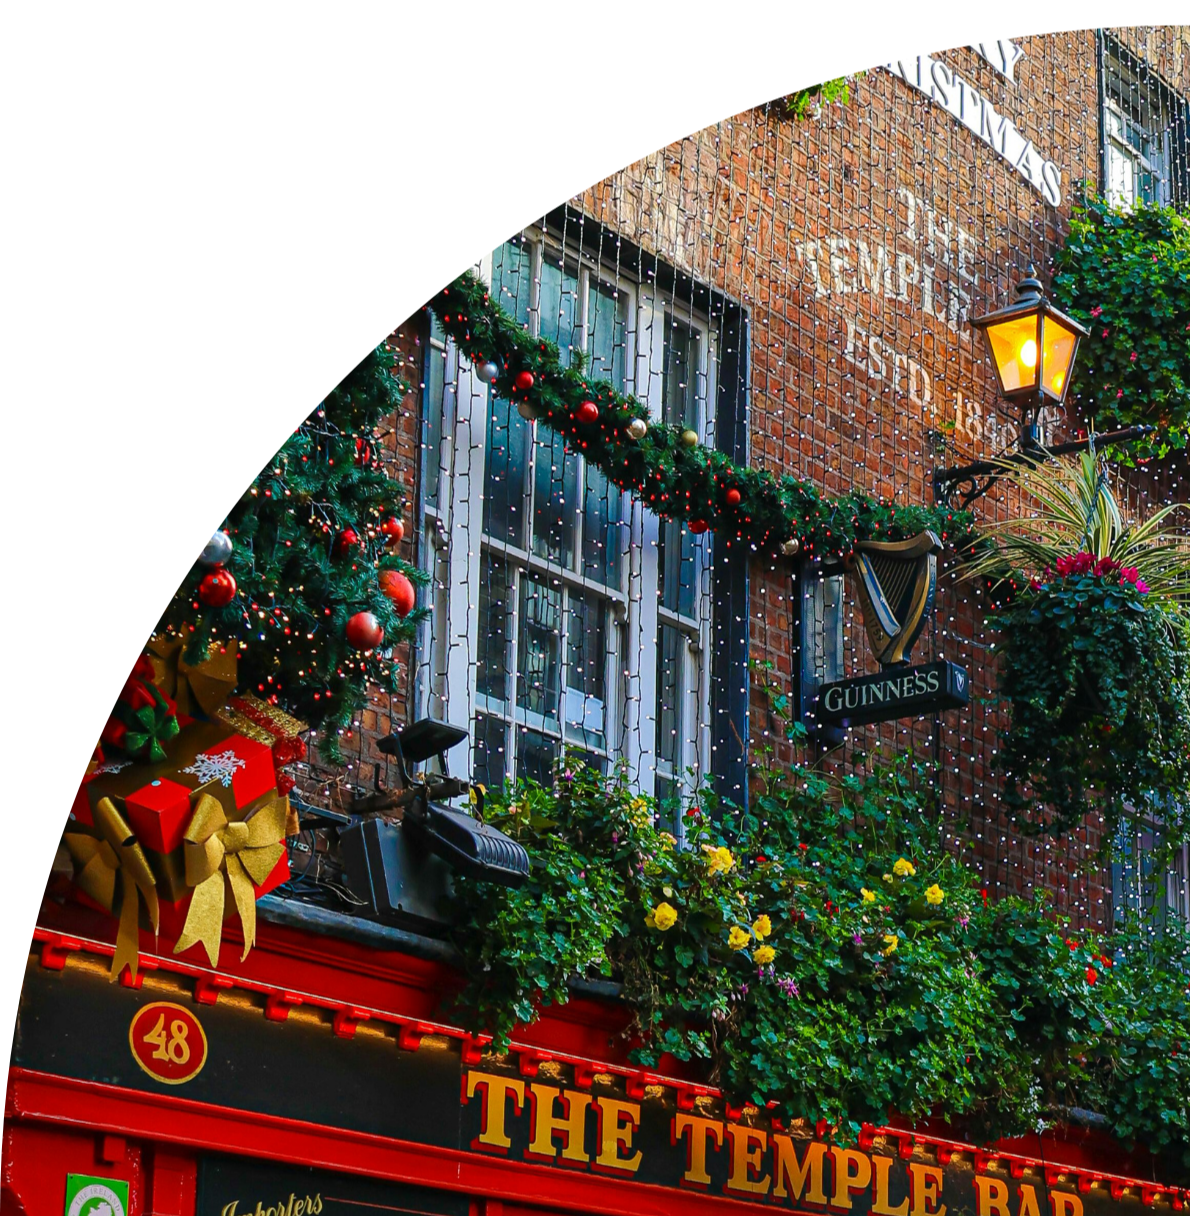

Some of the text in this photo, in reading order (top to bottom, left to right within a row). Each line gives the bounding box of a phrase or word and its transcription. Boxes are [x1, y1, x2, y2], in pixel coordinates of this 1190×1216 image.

[824, 670, 940, 712] GUINNESS
[143, 1012, 191, 1065] 48
[463, 1070, 643, 1175] THE
[75, 1186, 121, 1212] THE IRELAND
